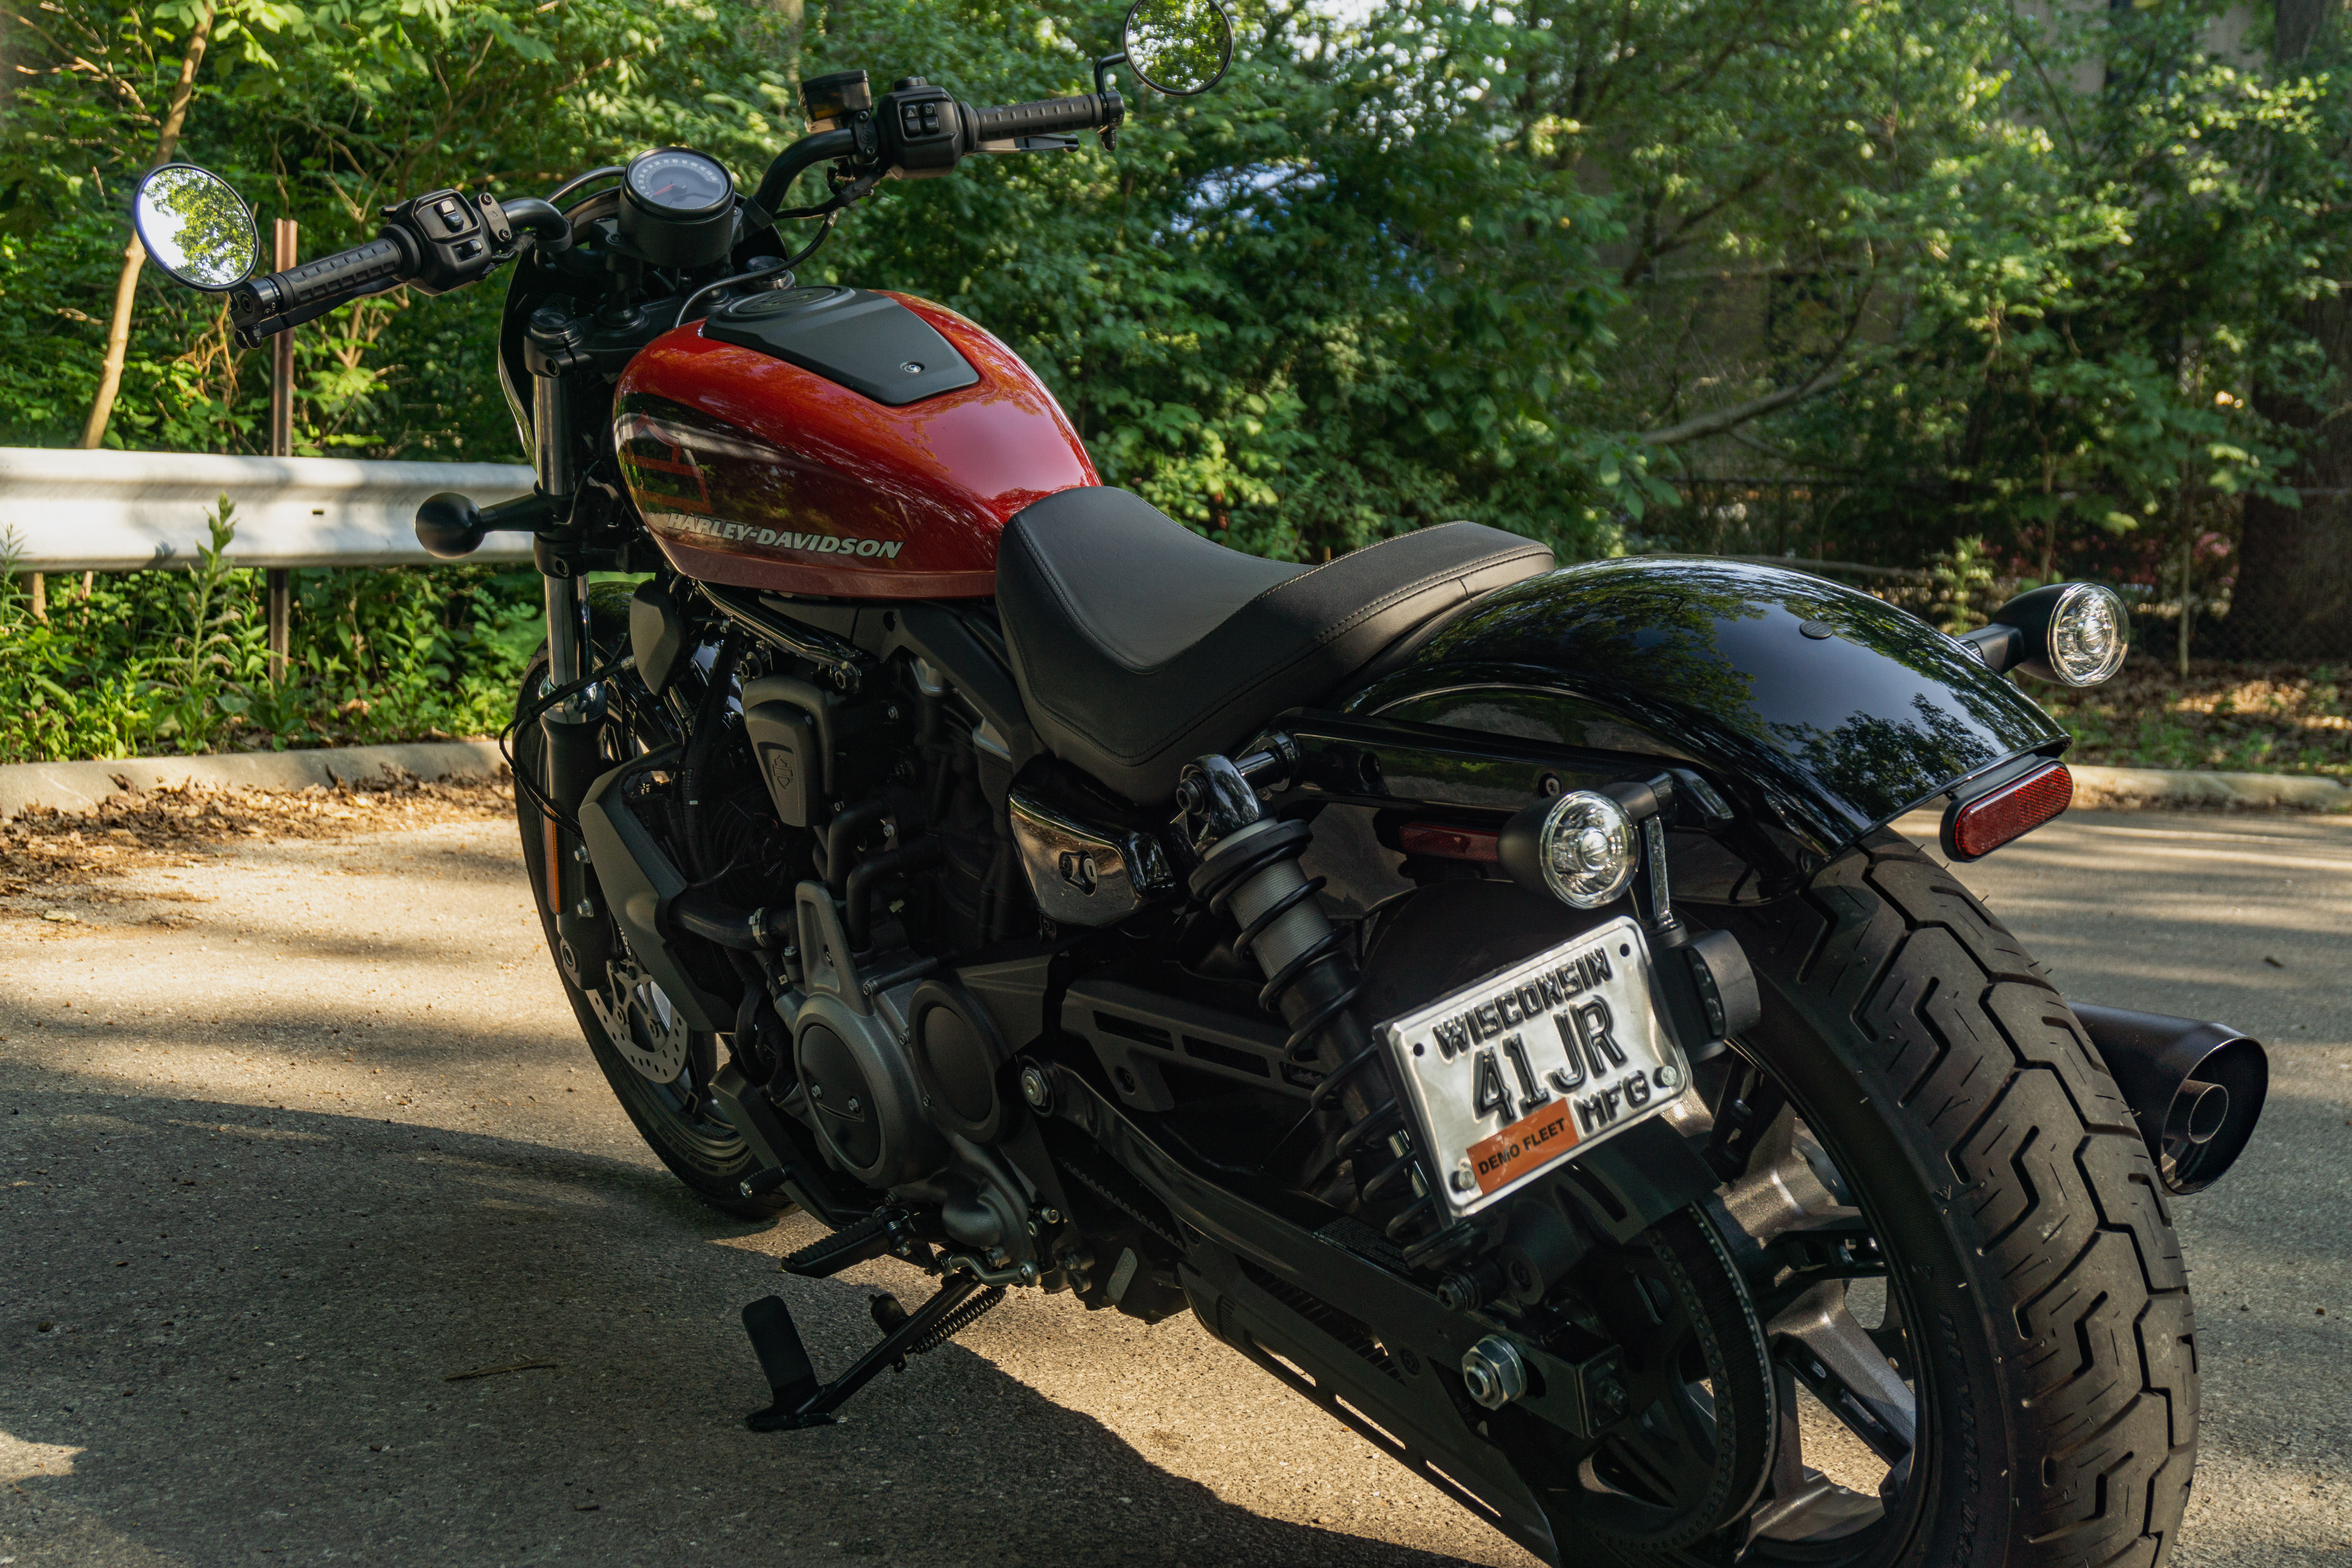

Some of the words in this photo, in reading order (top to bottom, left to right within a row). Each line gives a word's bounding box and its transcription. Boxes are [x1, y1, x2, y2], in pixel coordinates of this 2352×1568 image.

[667, 513, 905, 558] HARLEY-DAVIDSON
[1432, 947, 1613, 1060] WISCONSIN
[1472, 1034, 1549, 1125] 41
[1550, 995, 1627, 1092] JR
[1573, 1070, 1651, 1134] MFG
[1478, 1144, 1520, 1175] DEMO
[1522, 1117, 1565, 1151] FLEET
[1938, 1312, 1980, 1495] DUNLOP
